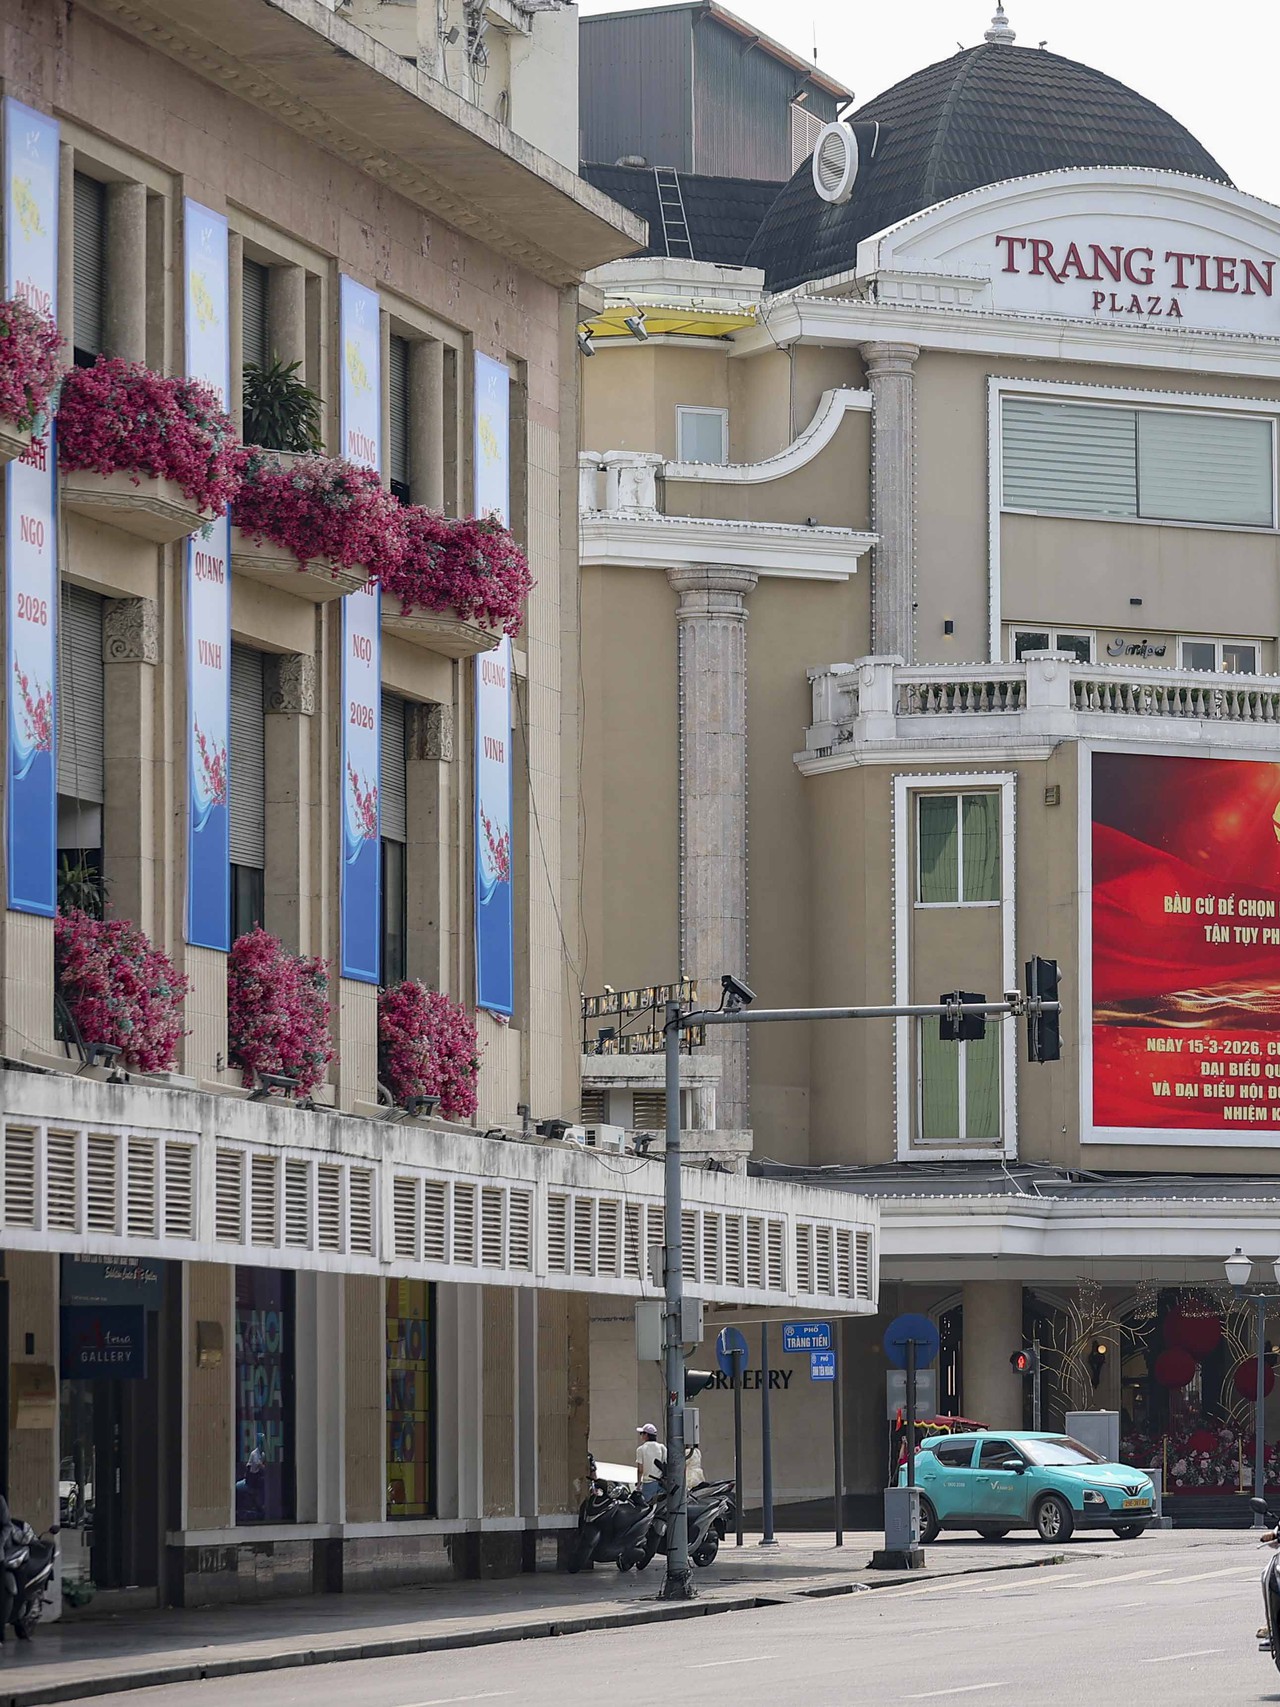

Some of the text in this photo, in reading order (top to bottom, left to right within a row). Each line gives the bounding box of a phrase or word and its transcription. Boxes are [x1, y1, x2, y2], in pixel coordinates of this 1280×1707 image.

[995, 235, 1276, 297] TRANG TIEN
[1092, 291, 1184, 318] PLAZA
[20, 515, 45, 554] NGỌ
[195, 551, 224, 584] QUANG
[17, 592, 47, 627] 2026
[198, 639, 222, 670] VINH
[352, 633, 372, 668] NGỌ
[482, 659, 506, 688] QUANG
[350, 701, 374, 730] 2026
[484, 736, 505, 764] VINH
[1163, 890, 1192, 914] BẦU
[1195, 893, 1216, 915] CỬ
[1218, 892, 1235, 916] ĐỂ
[1238, 899, 1275, 920] CHỌN
[1203, 922, 1230, 945] TẬN
[1233, 926, 1259, 947] TỤY
[1146, 1036, 1184, 1053] NGÀY
[1188, 1039, 1263, 1056] 15-3-2026,
[1201, 1061, 1224, 1078] ĐẠI
[1228, 1058, 1261, 1077] BIỂU
[1151, 1080, 1171, 1096] VÀ
[1175, 1083, 1199, 1100] ĐẠI
[1203, 1079, 1235, 1099] BIỂU
[1239, 1082, 1264, 1101] HỘI
[1223, 1104, 1268, 1123] NHIỆM
[787, 1335, 811, 1348] TRÀNG
[803, 1325, 819, 1333] PHỐ
[81, 1351, 132, 1362] GALLERY
